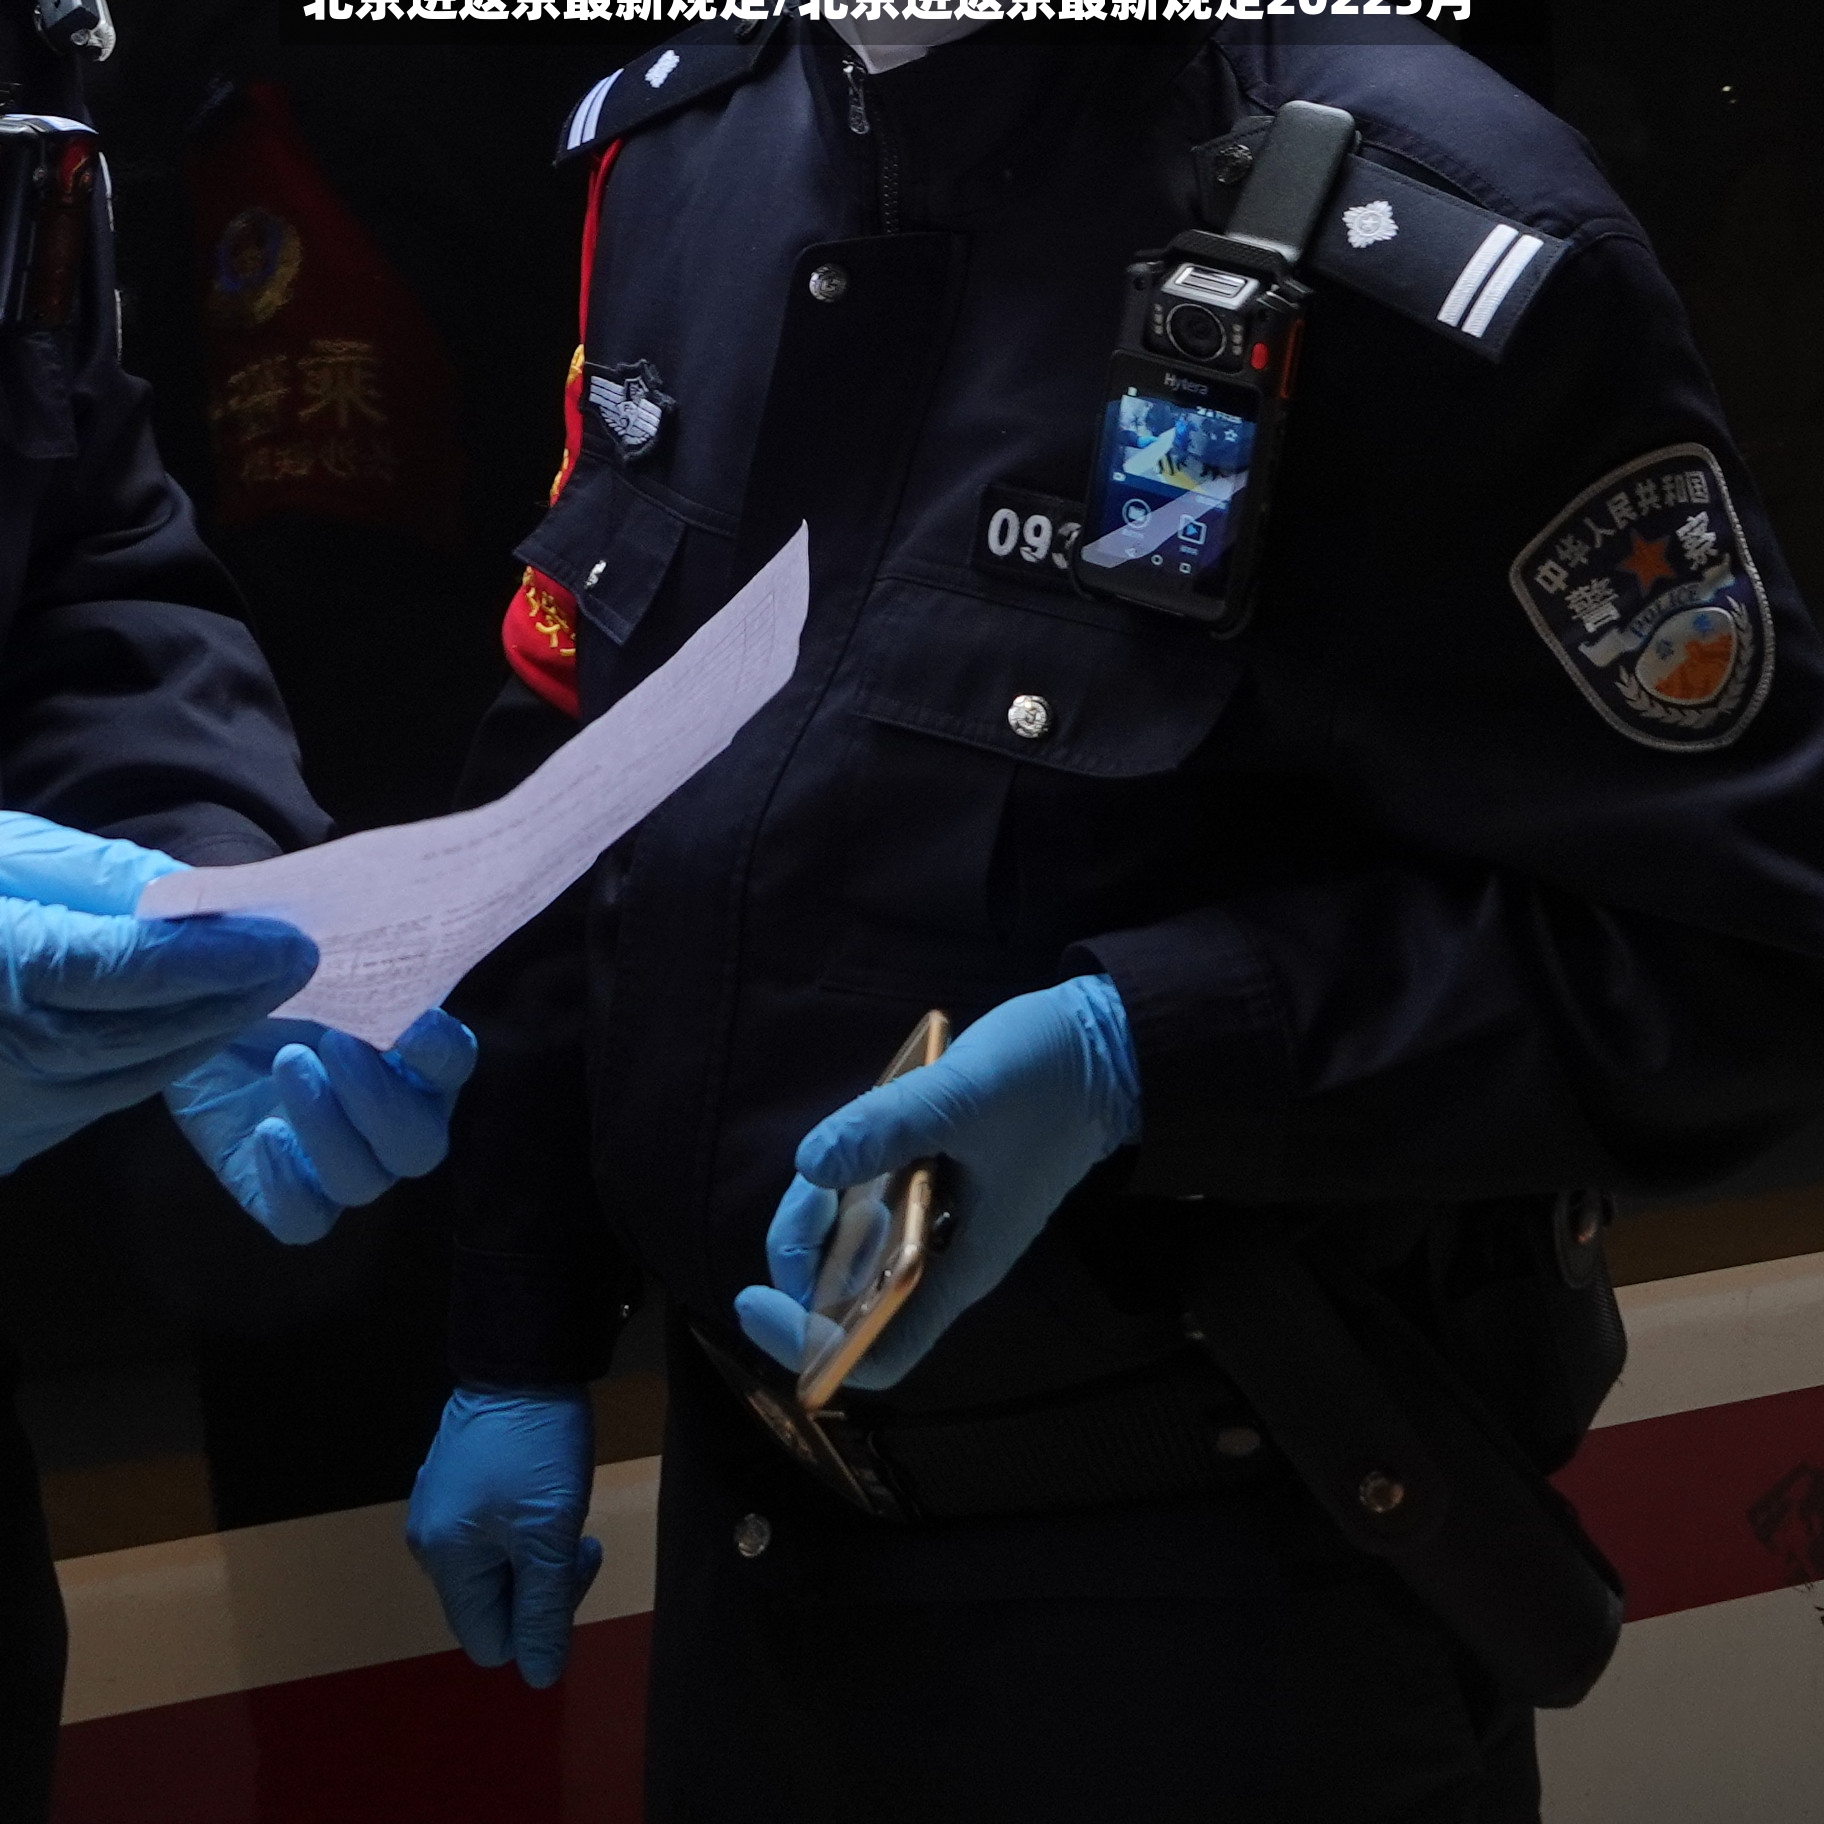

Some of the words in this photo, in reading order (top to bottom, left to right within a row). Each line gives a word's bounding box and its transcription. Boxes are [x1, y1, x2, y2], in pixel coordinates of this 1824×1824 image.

[1164, 372, 1209, 397] Hytera
[776, 507, 825, 524] POLICE
[1534, 470, 1711, 595] 中华人民共和国
